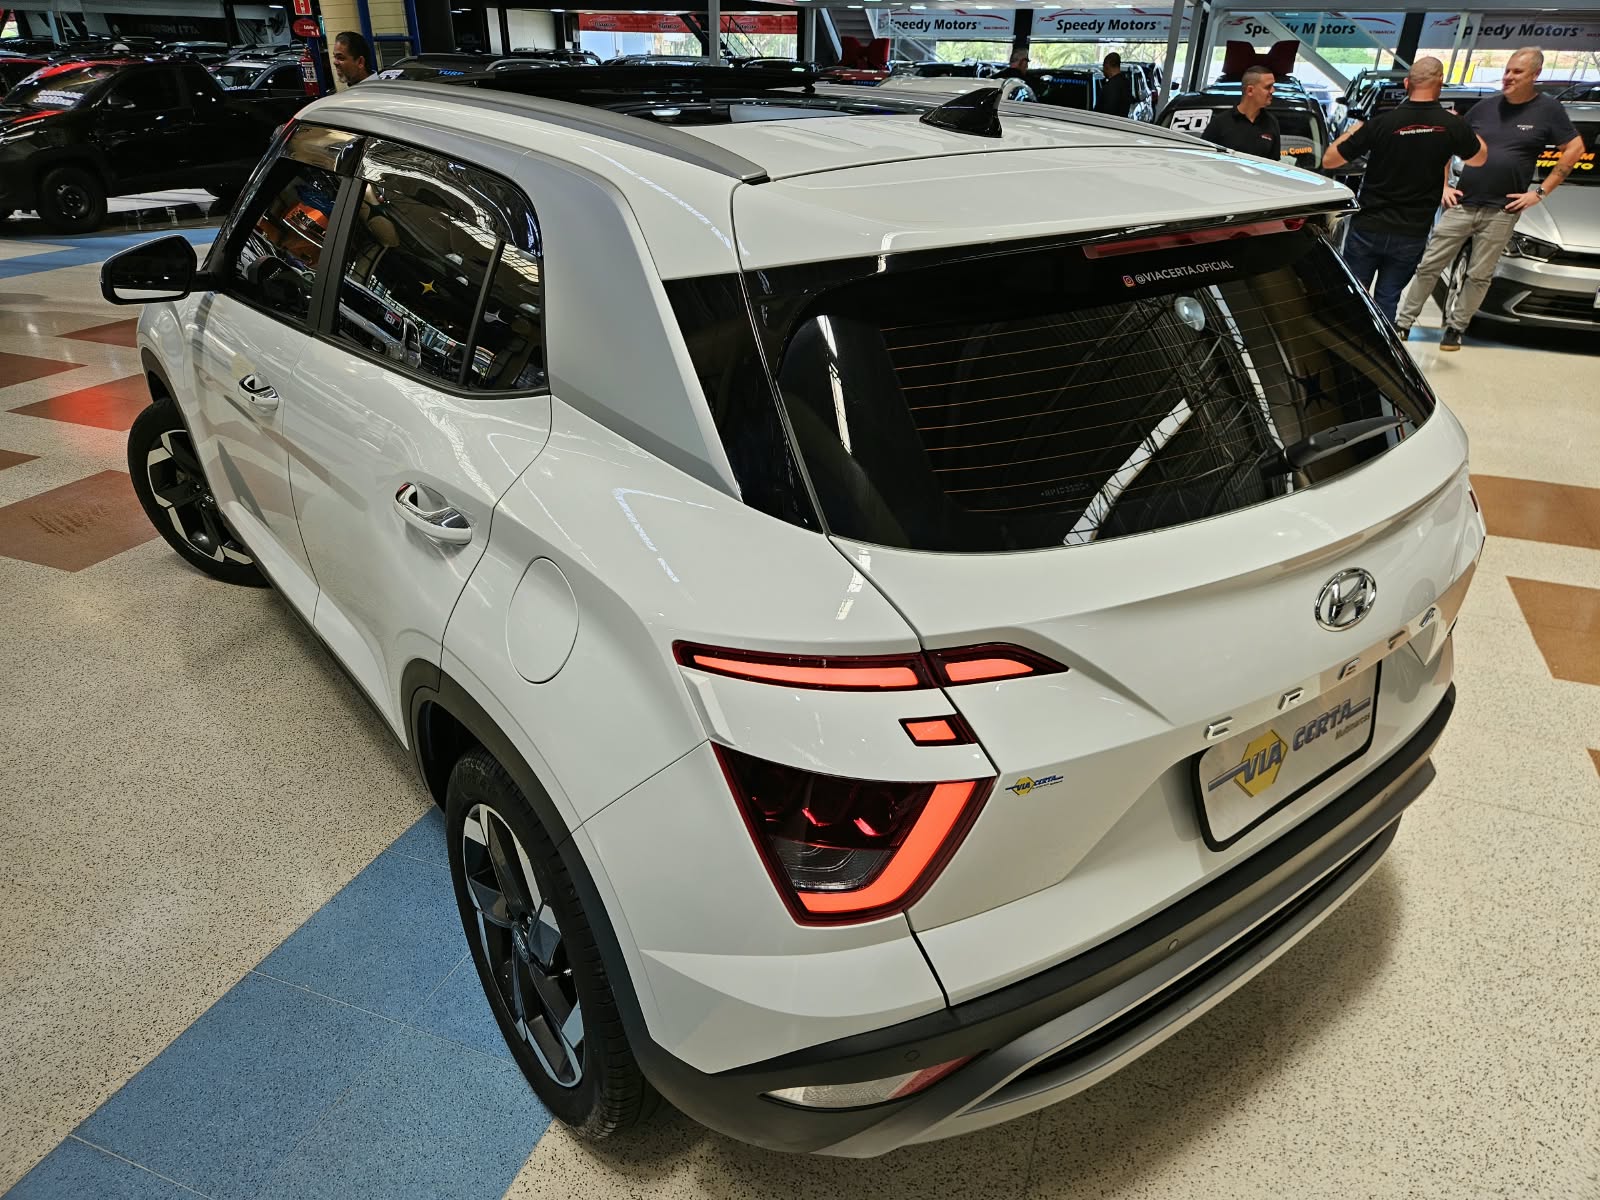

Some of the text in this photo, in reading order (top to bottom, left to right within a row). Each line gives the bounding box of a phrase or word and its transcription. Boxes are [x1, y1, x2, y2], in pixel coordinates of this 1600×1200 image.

[890, 19, 977, 32] peedy Motors
[1056, 20, 1157, 33] Speedy Motors
[1244, 23, 1299, 37] Spey
[1454, 23, 1579, 40] peedy Motors
[1135, 260, 1235, 285] @VIACERTA.OFICIAL
[1228, 698, 1358, 786] VIA CERTA
